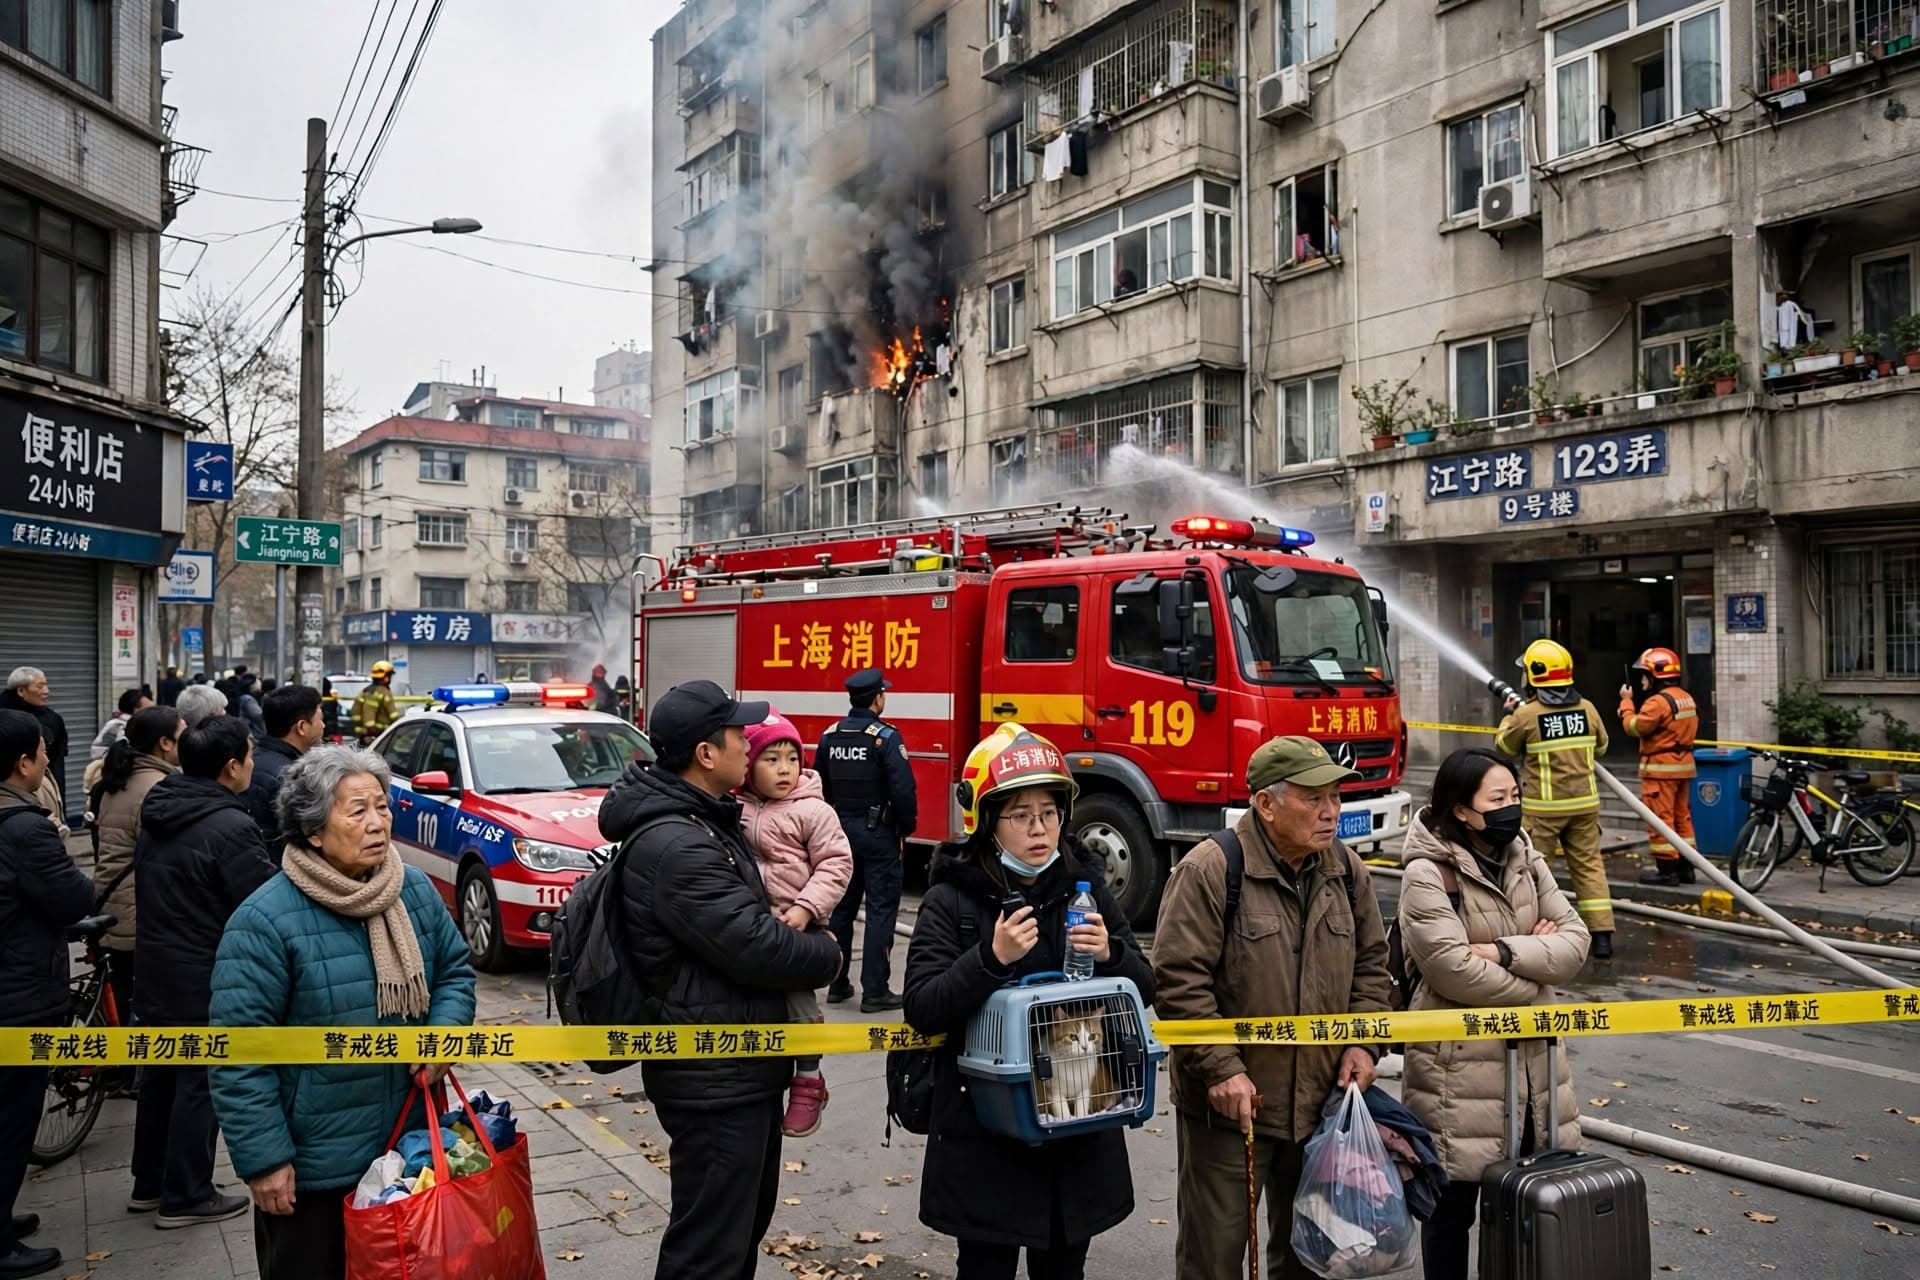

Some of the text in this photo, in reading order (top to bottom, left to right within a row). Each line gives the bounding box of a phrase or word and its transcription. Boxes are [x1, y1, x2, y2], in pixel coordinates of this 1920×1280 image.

[21, 411, 124, 483] 便利店
[1430, 434, 1660, 496] 江宁路 123弄
[28, 474, 96, 513] 24小时
[1504, 491, 1574, 521] 9号楼
[260, 523, 321, 546] 江宁路
[257, 544, 326, 562] Jiangning Rd
[411, 614, 472, 641] 药房
[763, 618, 921, 670] 上海消防
[1129, 700, 1195, 747] 119
[1308, 705, 1378, 733] 上海消防
[1544, 713, 1585, 738] 消防
[829, 746, 868, 761] POLICE
[998, 746, 1060, 775] 上海消防
[416, 810, 438, 849] 110
[1462, 1008, 1611, 1036] 警戒线 请勿靠近
[1679, 1000, 1819, 1027] 警戒线 请勿靠近
[607, 1029, 786, 1056] 警戒线 请勿靠近
[1234, 1017, 1392, 1042] 警戒线 请勿靠近
[29, 1033, 230, 1060] 警戒线 请勿靠近
[324, 1032, 514, 1059] 警戒线 请勿靠近
